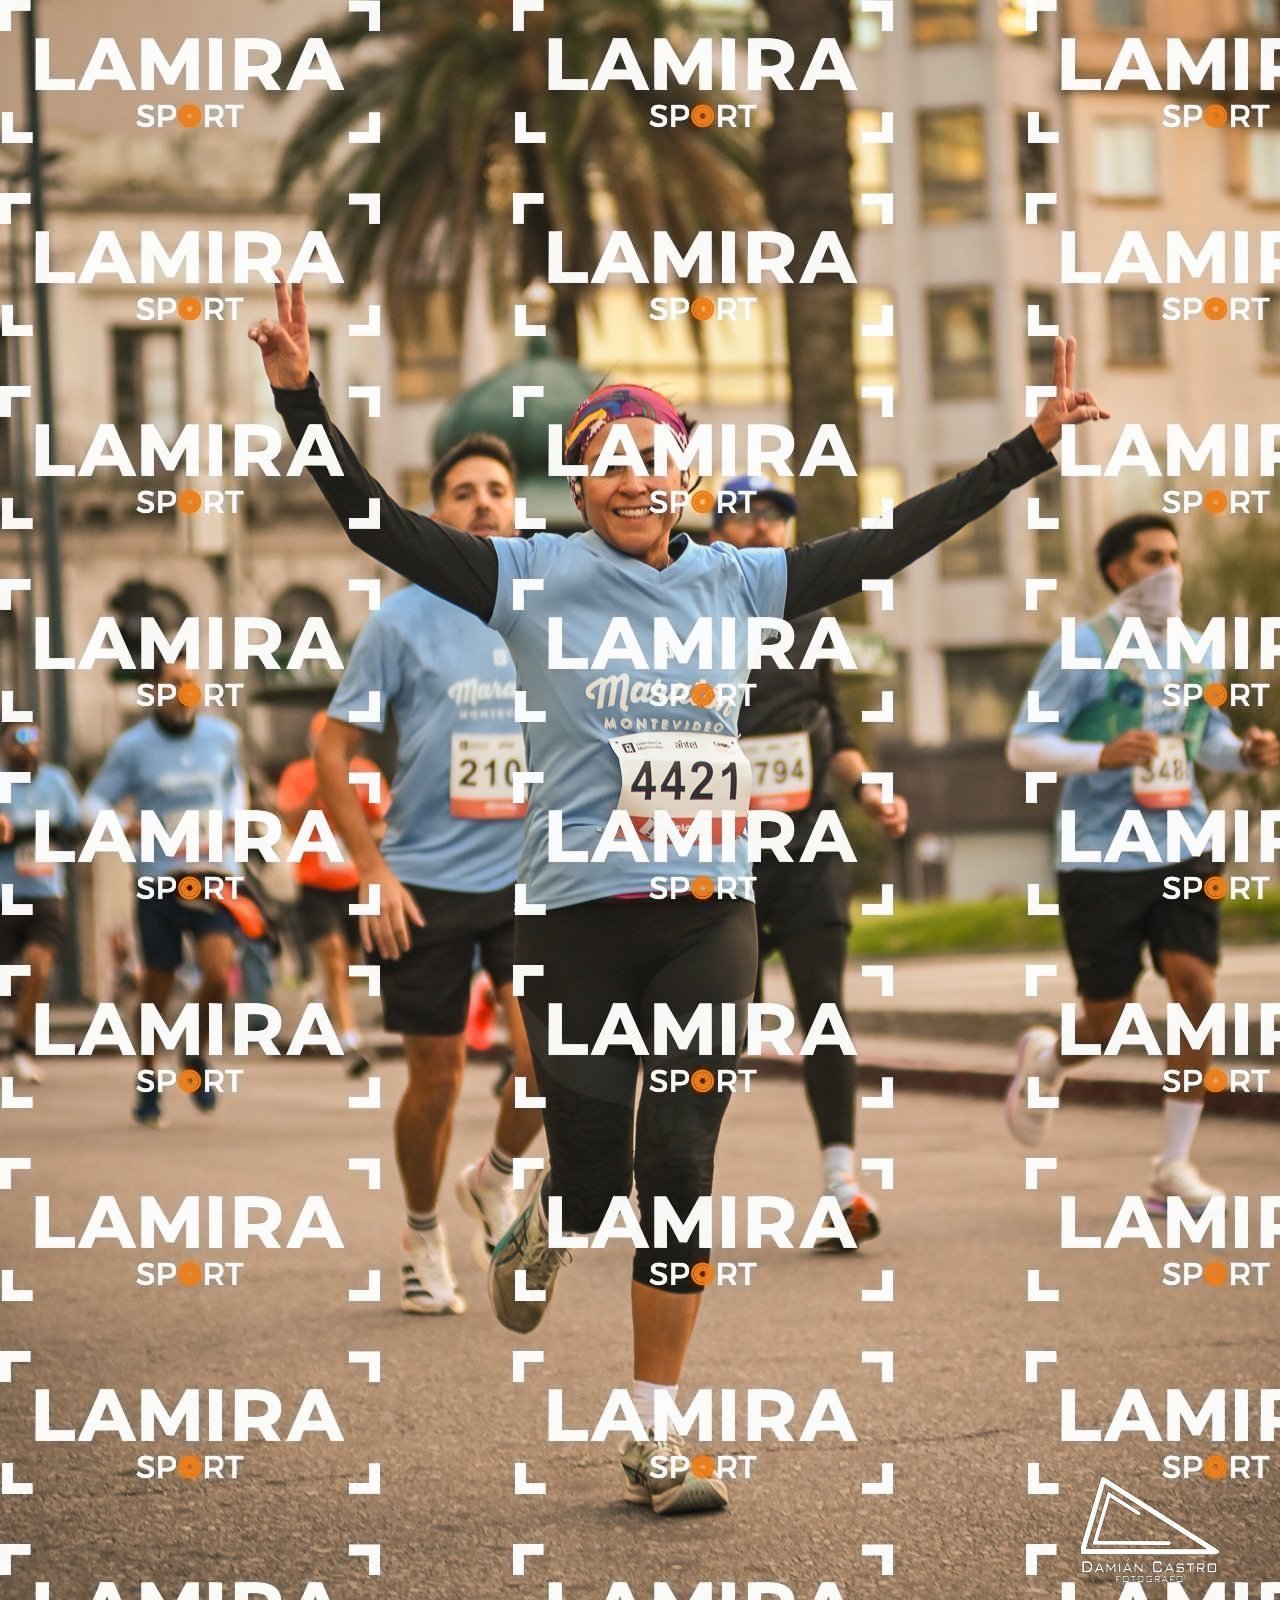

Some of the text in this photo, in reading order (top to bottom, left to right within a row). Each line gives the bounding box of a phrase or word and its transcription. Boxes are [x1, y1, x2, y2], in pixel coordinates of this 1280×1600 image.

[604, 716, 724, 733] MONTEVIDEO
[674, 740, 699, 750] antel
[630, 760, 738, 801] 4421
